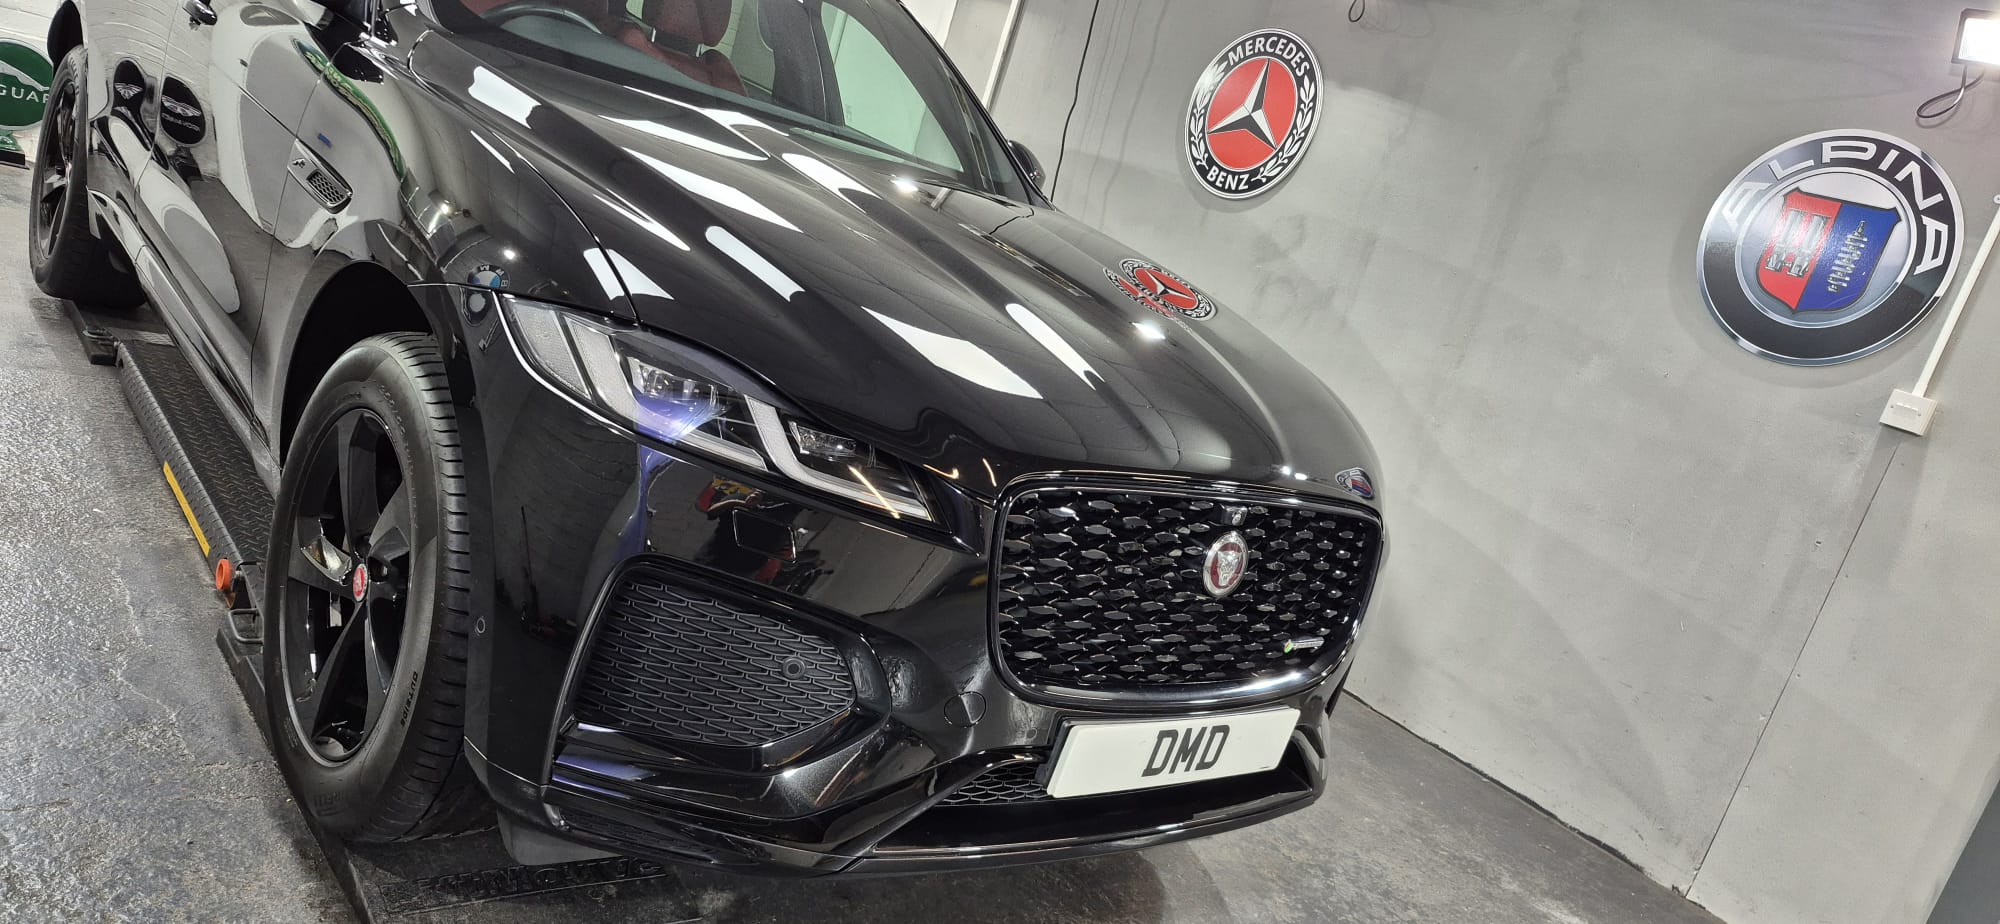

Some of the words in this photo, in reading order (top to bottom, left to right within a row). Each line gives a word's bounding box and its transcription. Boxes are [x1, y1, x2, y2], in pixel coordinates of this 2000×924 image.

[1227, 36, 1311, 78] MERCEDES
[1206, 165, 1250, 191] BENZ
[1720, 140, 1949, 276] ALPINA
[1141, 724, 1230, 778] DMD
